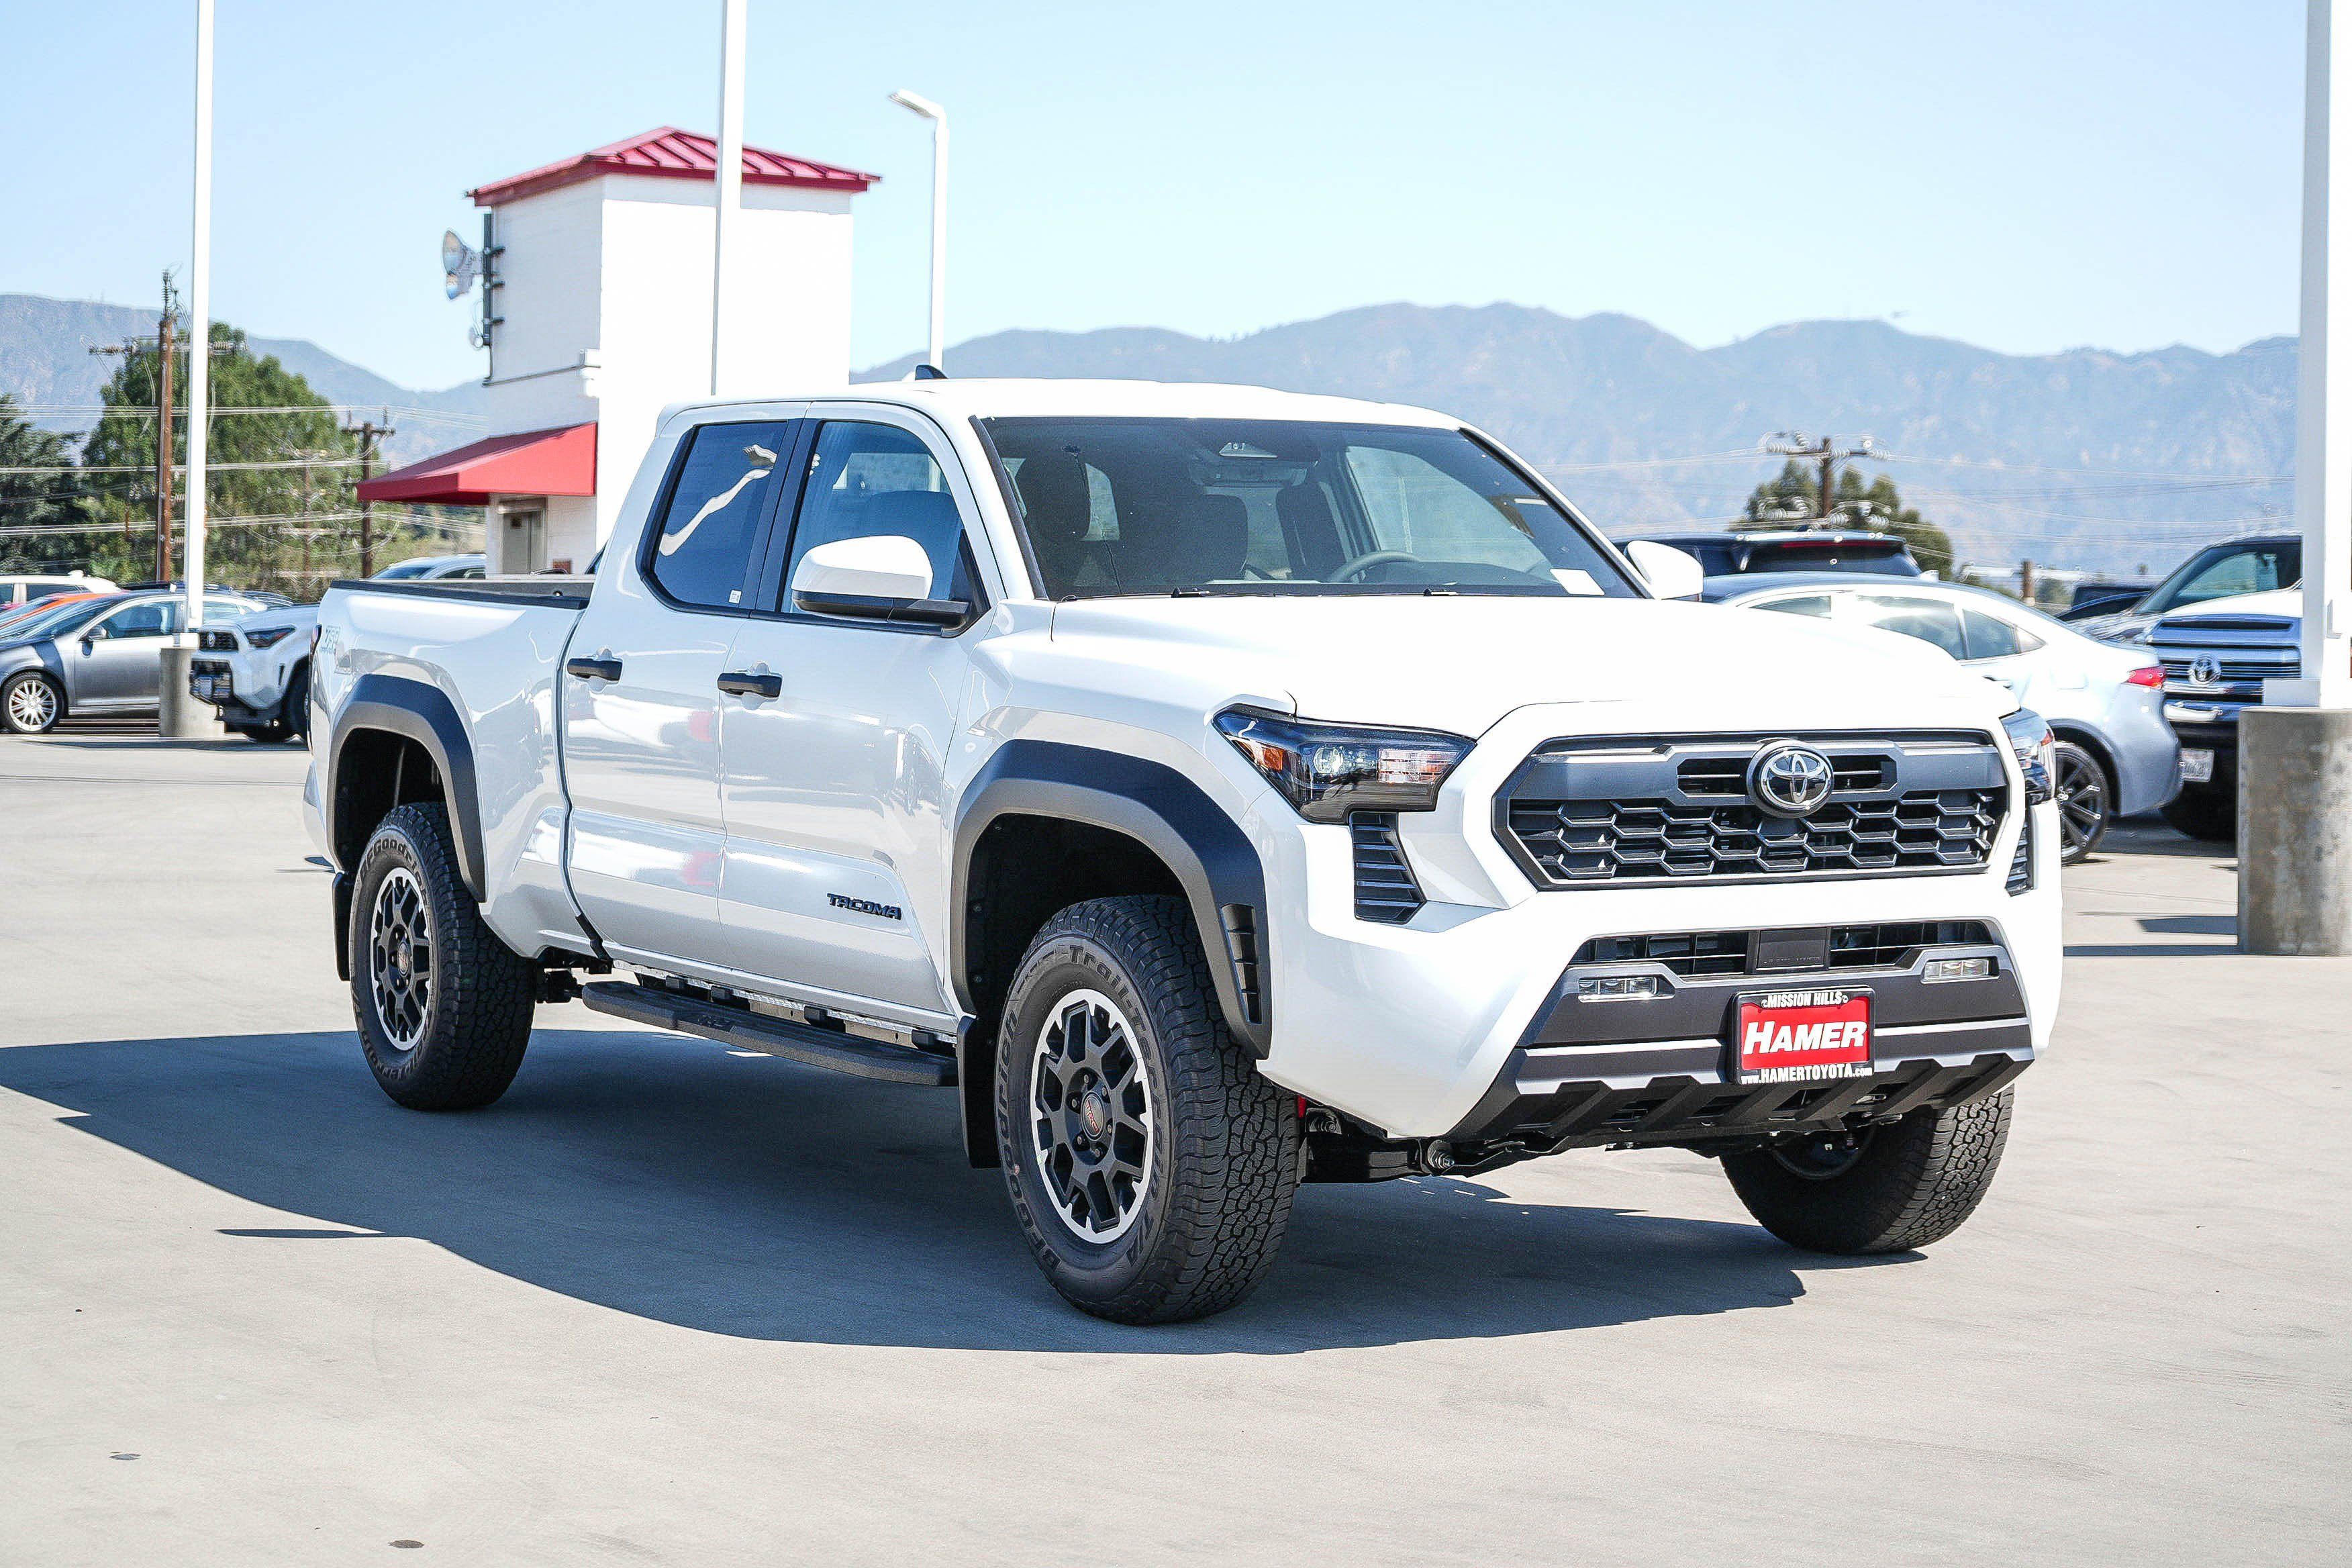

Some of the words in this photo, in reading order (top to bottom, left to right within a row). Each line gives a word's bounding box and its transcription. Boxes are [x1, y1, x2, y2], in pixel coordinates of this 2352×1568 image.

[827, 893, 902, 920] TACOMA
[1767, 993, 1812, 1008] MISSION
[1812, 991, 1843, 1007] HILLS
[1742, 1020, 1868, 1055] HAMER
[1741, 1063, 1873, 1085] www.HAMERTOYOTA.com
[995, 1012, 1063, 1272] BFGoodrich
